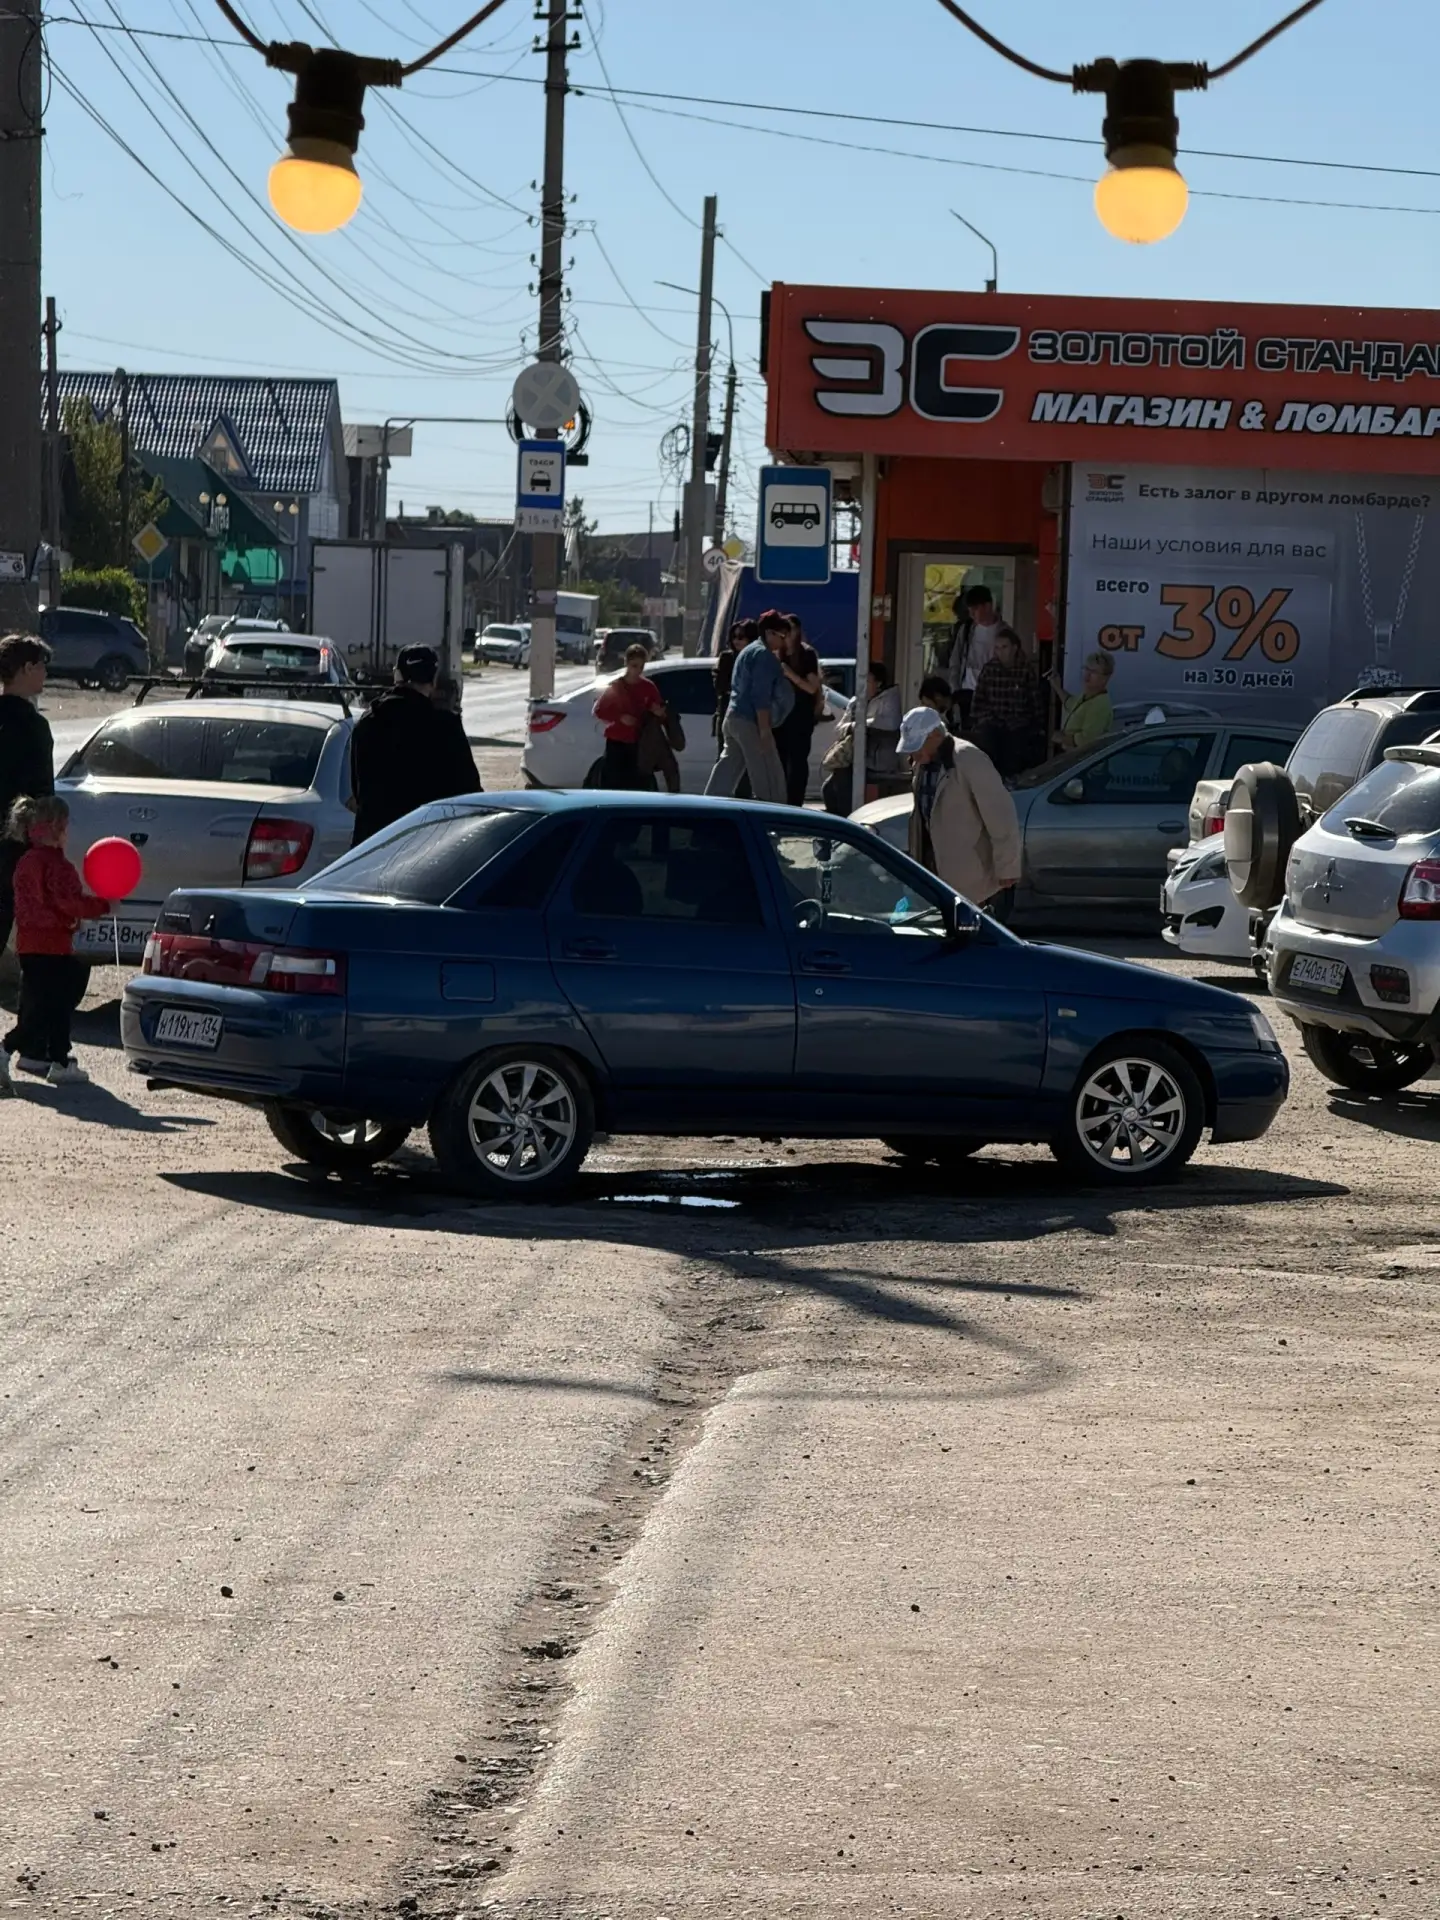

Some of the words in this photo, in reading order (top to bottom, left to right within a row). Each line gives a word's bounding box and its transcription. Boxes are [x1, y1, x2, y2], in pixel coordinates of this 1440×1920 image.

[1028, 328, 1246, 371] ЗОЛОТОЙ
[1255, 337, 1440, 382] СТАНДА
[1030, 391, 1232, 431] МАГАЗИН
[1239, 400, 1266, 431] &
[1139, 484, 1179, 499] Есть
[1184, 487, 1236, 501] залог
[1241, 490, 1251, 500] в
[1256, 491, 1323, 505] другом
[1328, 492, 1431, 510] ломбарде?
[1092, 534, 1150, 551] Наши
[1156, 540, 1242, 555] условия
[1247, 542, 1285, 557] для
[1292, 544, 1327, 558] вас
[1096, 579, 1150, 594] всего
[1097, 624, 1146, 652] от
[1154, 583, 1301, 664] 3%
[1184, 670, 1208, 683] на
[1213, 668, 1237, 685] 30
[1241, 670, 1294, 688] дней
[201, 1015, 218, 1036] 134
